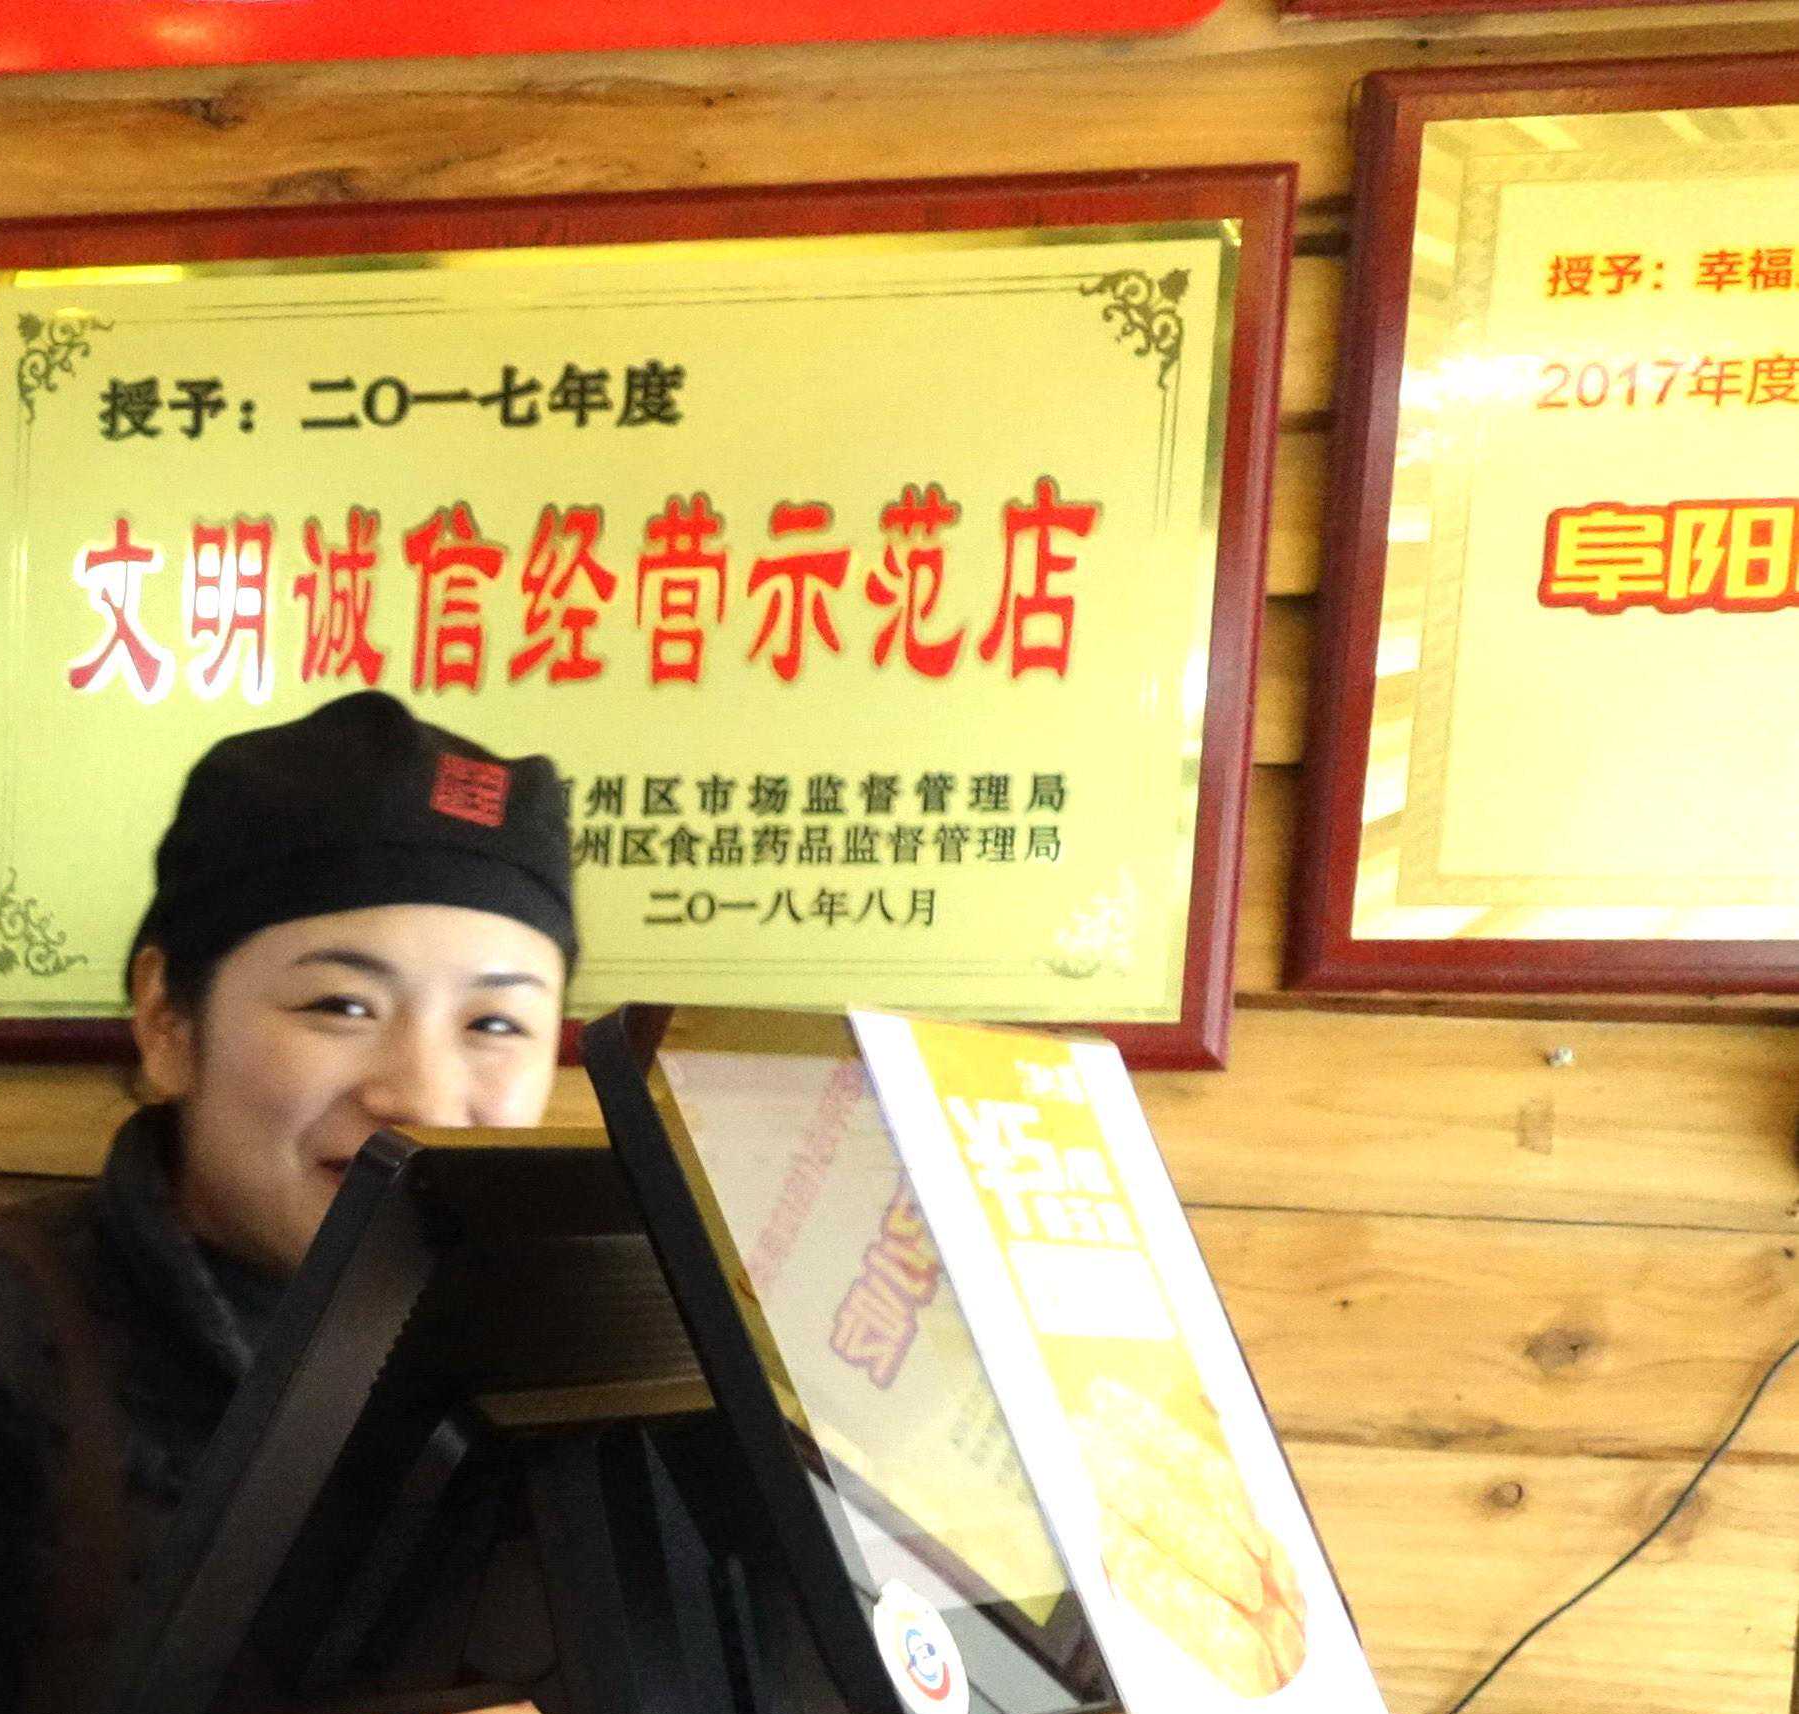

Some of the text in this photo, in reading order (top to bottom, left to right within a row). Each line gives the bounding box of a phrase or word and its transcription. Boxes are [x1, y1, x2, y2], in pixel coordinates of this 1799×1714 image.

[1547, 248, 1799, 298] 授予：幸福
[1540, 500, 1799, 613] 阜阳
[64, 474, 1103, 702] 文明诚信经营示范店
[559, 770, 1069, 818] 州区市场监督管理局
[575, 824, 1063, 867] 州区食品药品监督管理局
